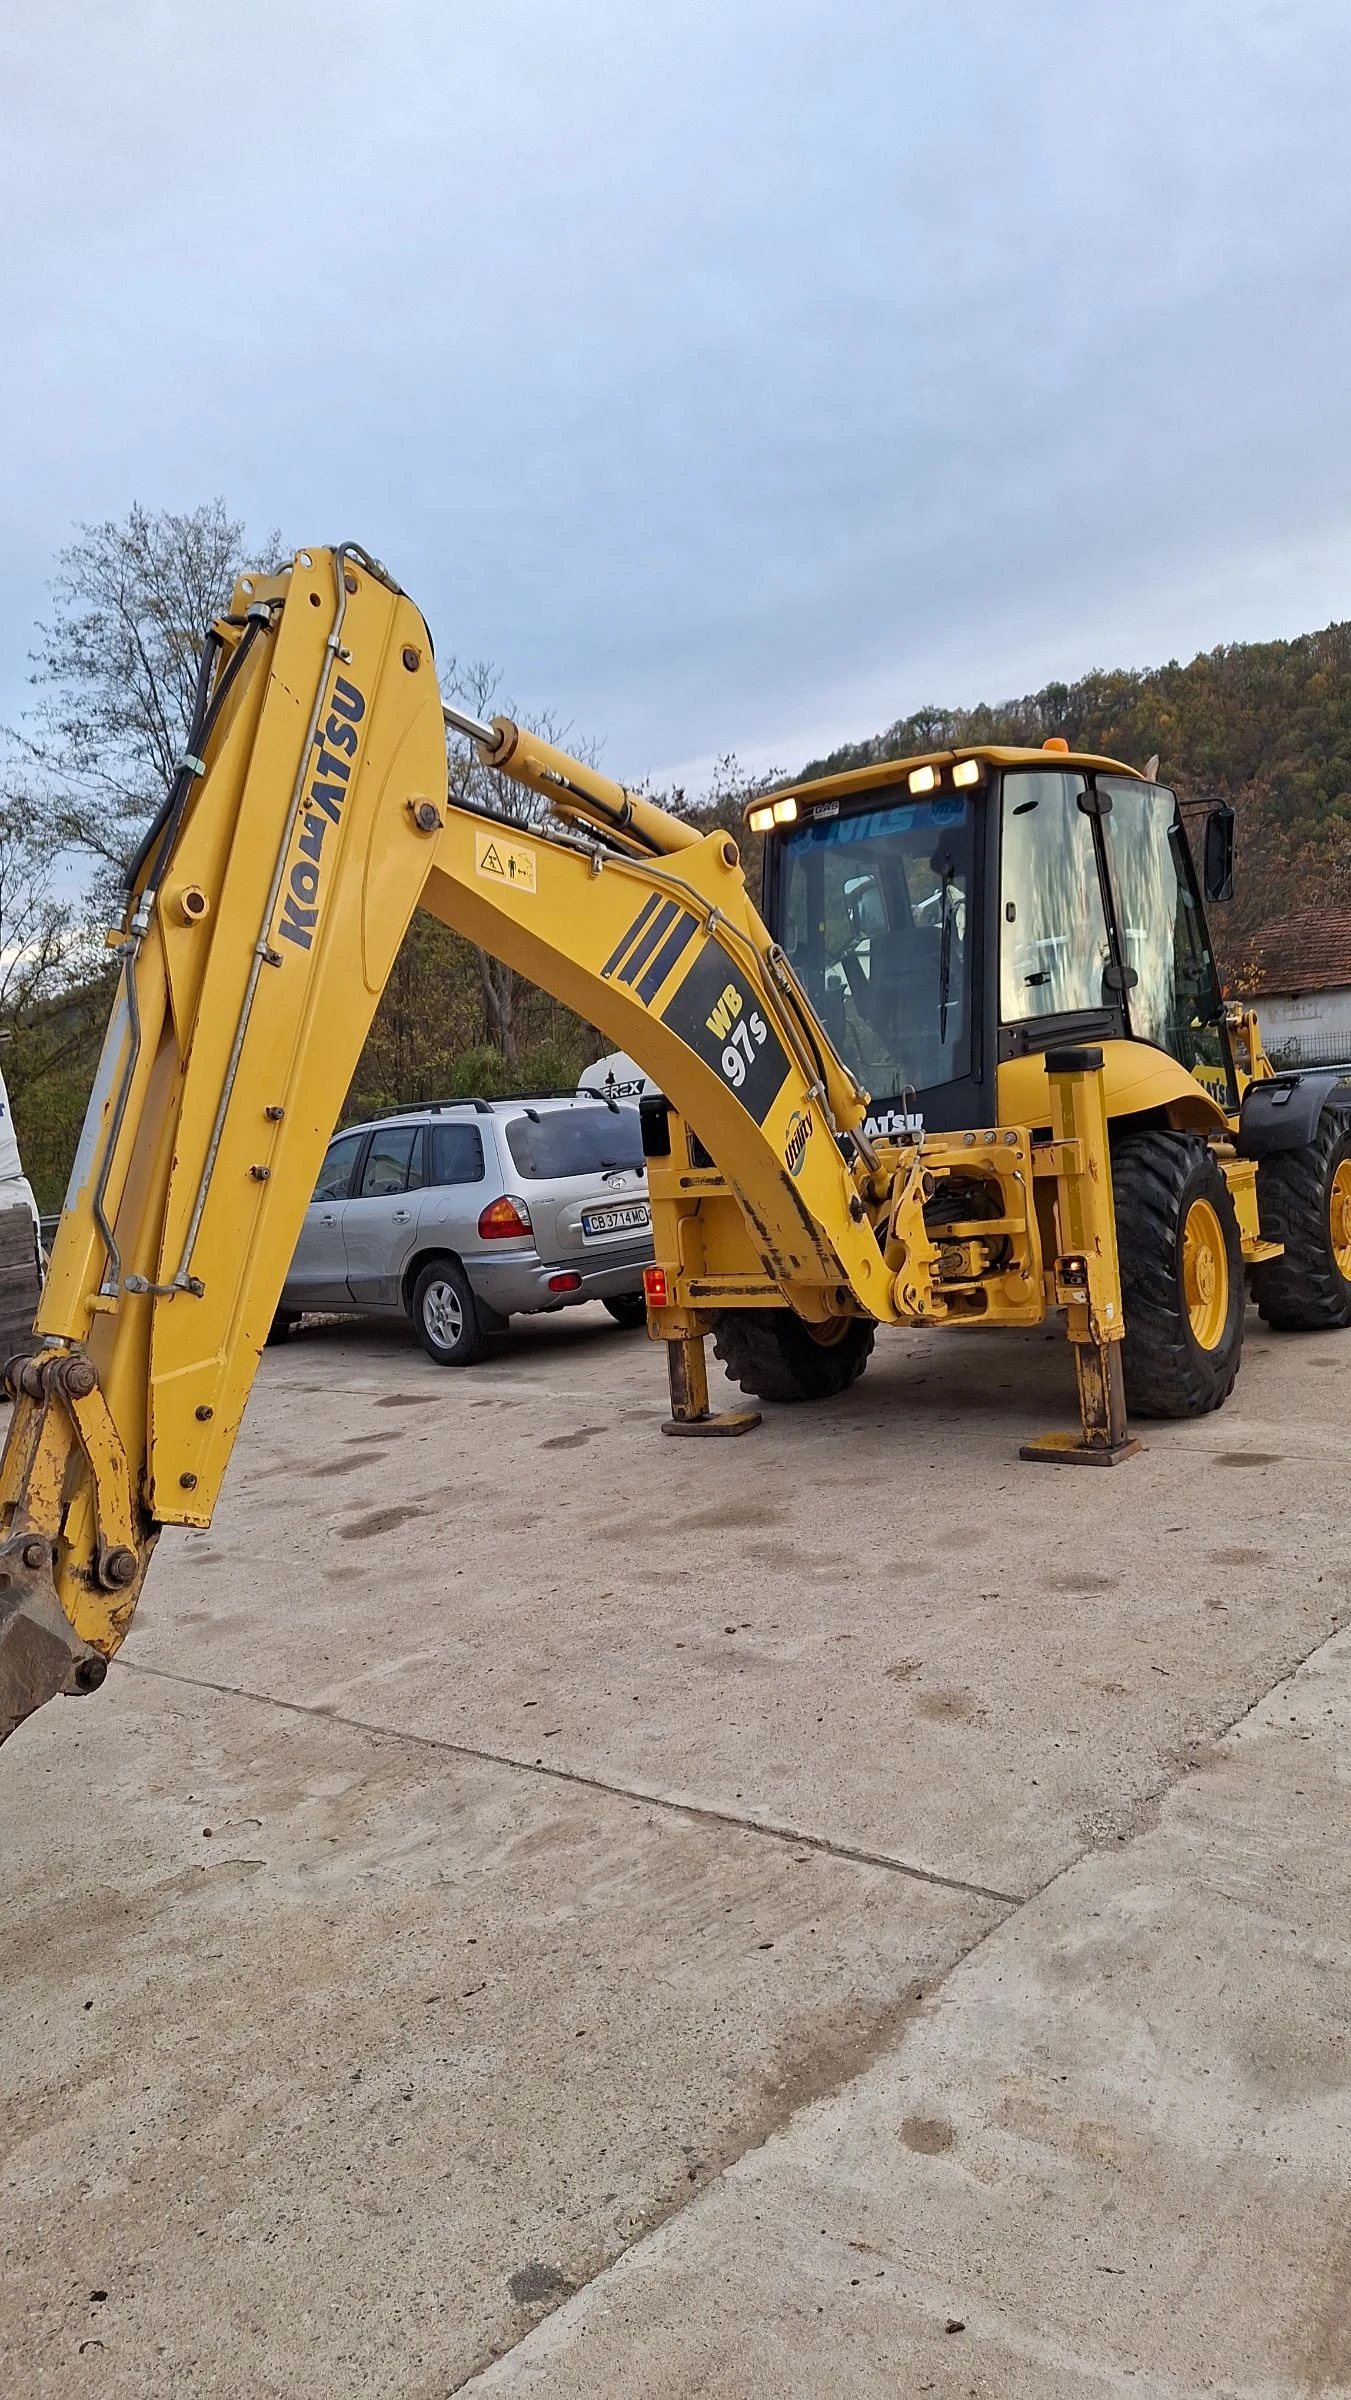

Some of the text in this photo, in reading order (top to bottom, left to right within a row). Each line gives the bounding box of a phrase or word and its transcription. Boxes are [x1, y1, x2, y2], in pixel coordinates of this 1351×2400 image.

[278, 675, 366, 951] KOMATSU
[824, 804, 916, 848] NILS
[705, 983, 743, 1041] WB
[785, 1109, 813, 1171] Utility
[591, 1209, 646, 1229] CB 3714 MC
